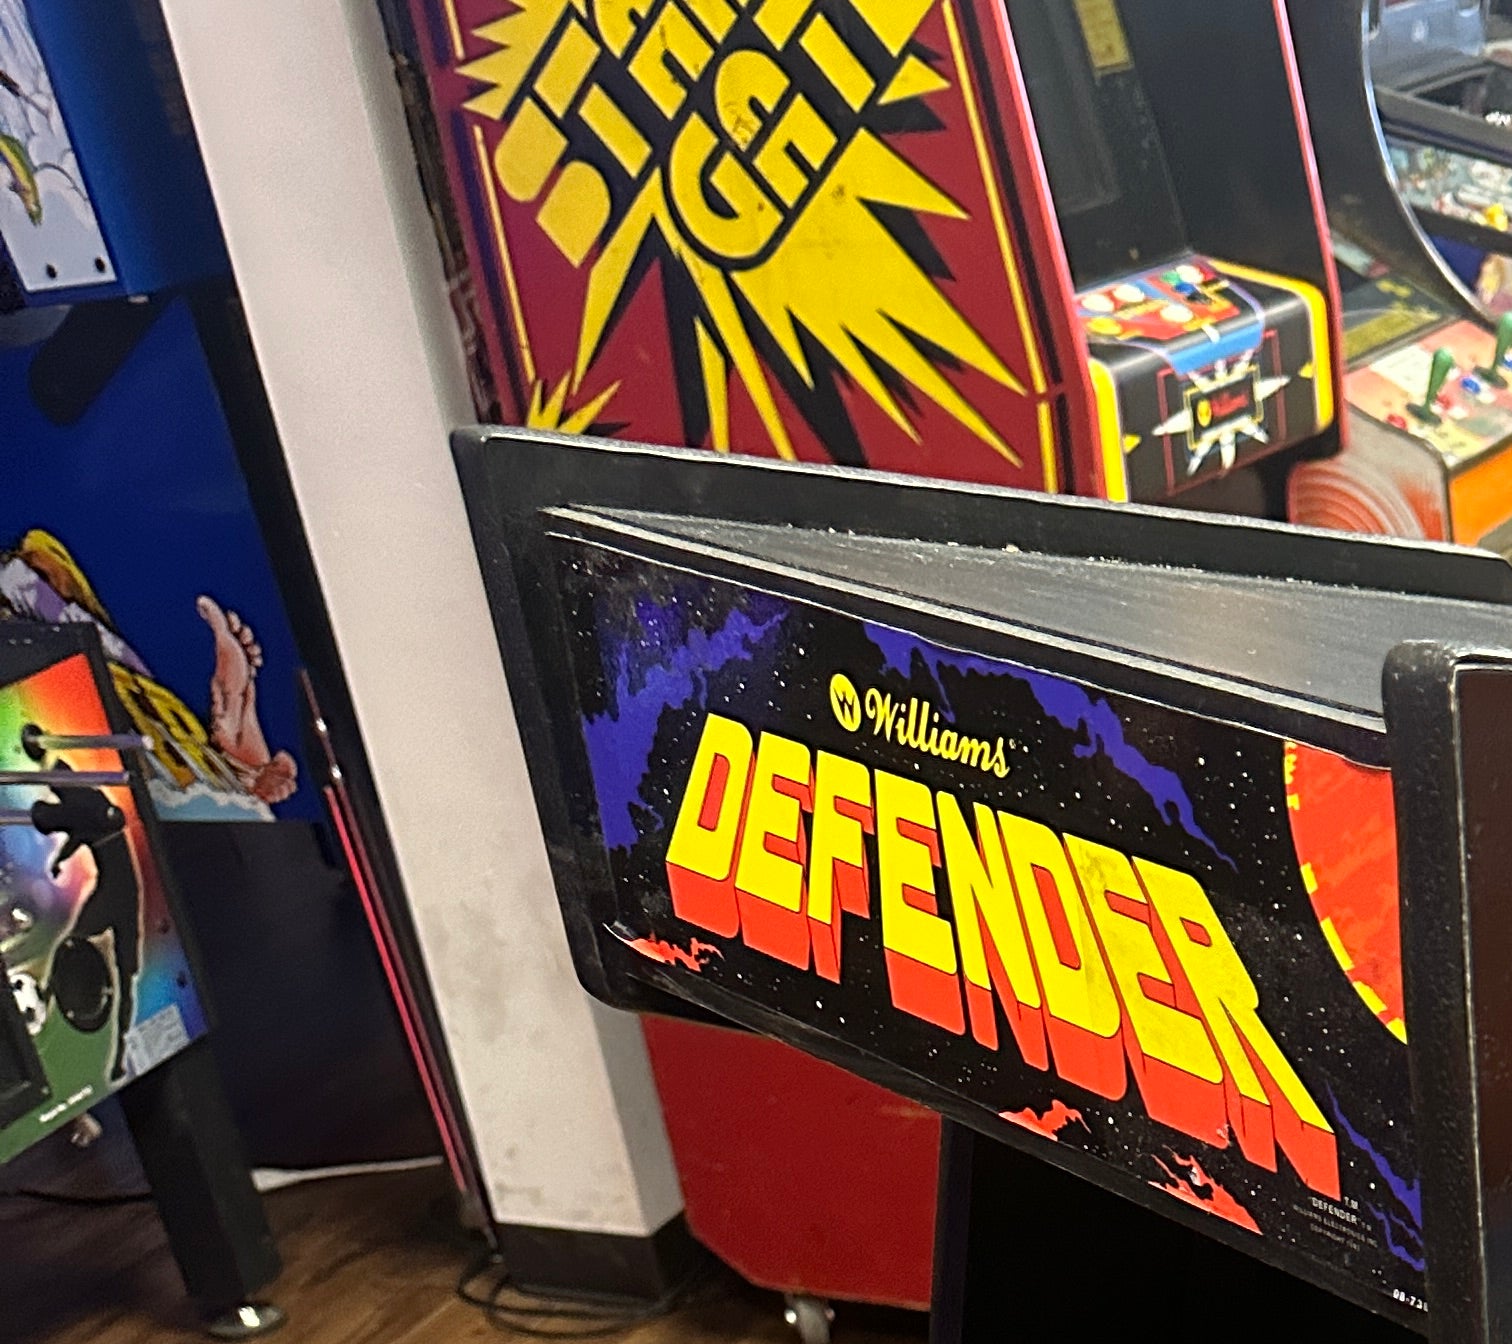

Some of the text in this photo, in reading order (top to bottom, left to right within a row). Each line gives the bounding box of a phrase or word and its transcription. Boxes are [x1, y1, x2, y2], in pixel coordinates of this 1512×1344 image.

[494, 0, 745, 268] STA
[865, 687, 1010, 778] Williams
[666, 712, 1340, 1199] DEFENDER
